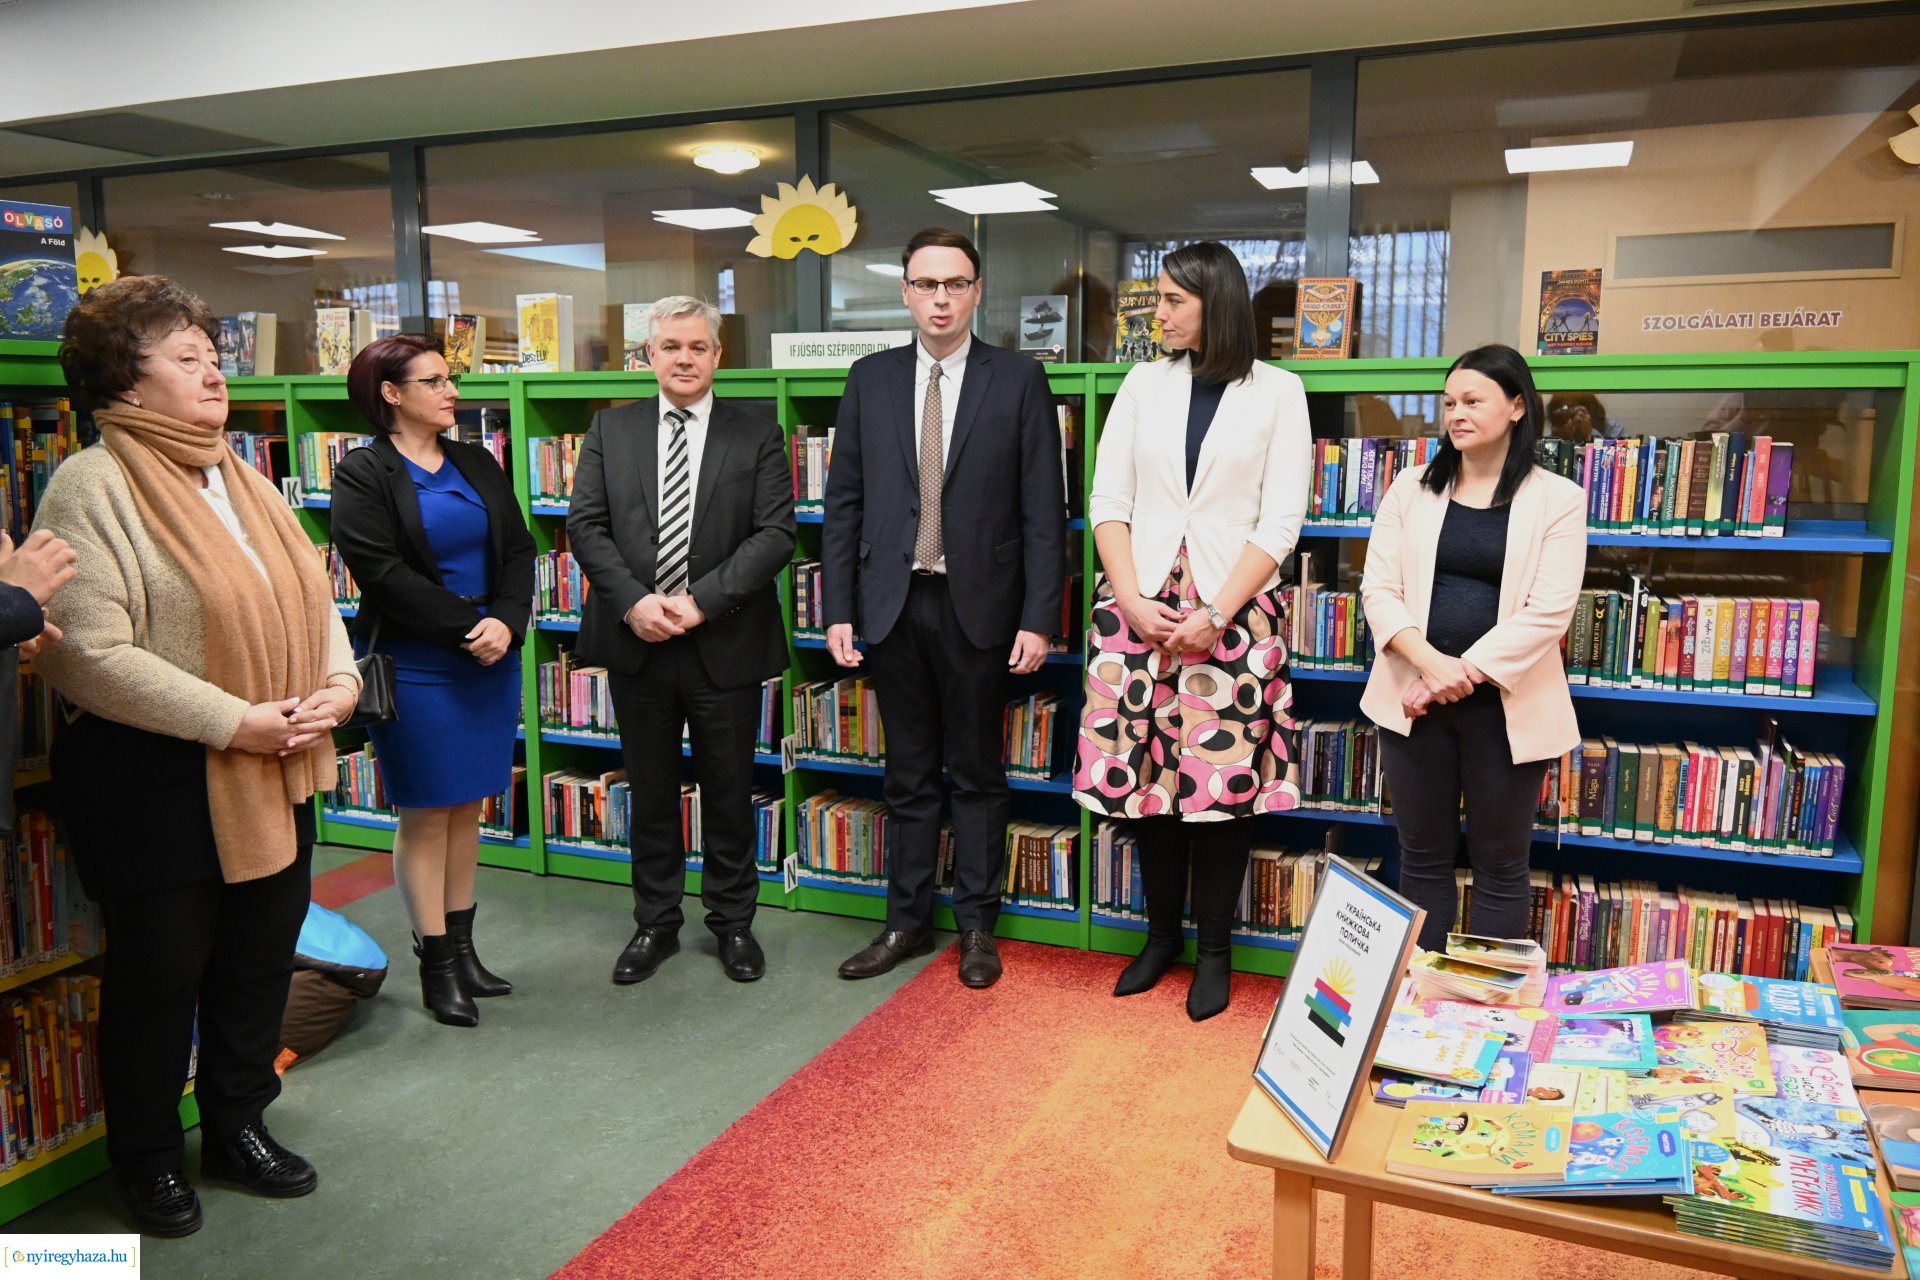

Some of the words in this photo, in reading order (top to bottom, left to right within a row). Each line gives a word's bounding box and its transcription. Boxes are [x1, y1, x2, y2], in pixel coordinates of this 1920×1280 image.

[4, 212, 64, 229] OLVASÓ
[48, 238, 65, 247] Föld
[1642, 310, 1754, 331] SZOLGÁLATI
[1760, 306, 1842, 328] BEJÁRAT
[790, 342, 825, 357] IFJÚSÁGI
[1544, 332, 1567, 342] CITY
[1567, 331, 1594, 341] SPIES
[287, 481, 300, 506] K
[784, 743, 795, 771] N
[1588, 778, 1601, 800] Mága
[786, 860, 797, 888] N
[1336, 909, 1370, 939] КНИЖКОВА
[1345, 902, 1381, 932] УКРАЇНСЬКА
[1340, 926, 1369, 954] ПОЛИЧКА
[1496, 1112, 1537, 1166] КОМАХИ
[1608, 1119, 1650, 1174] КОСМОС
[1790, 1154, 1824, 1217] МЕТЕЛИК?
